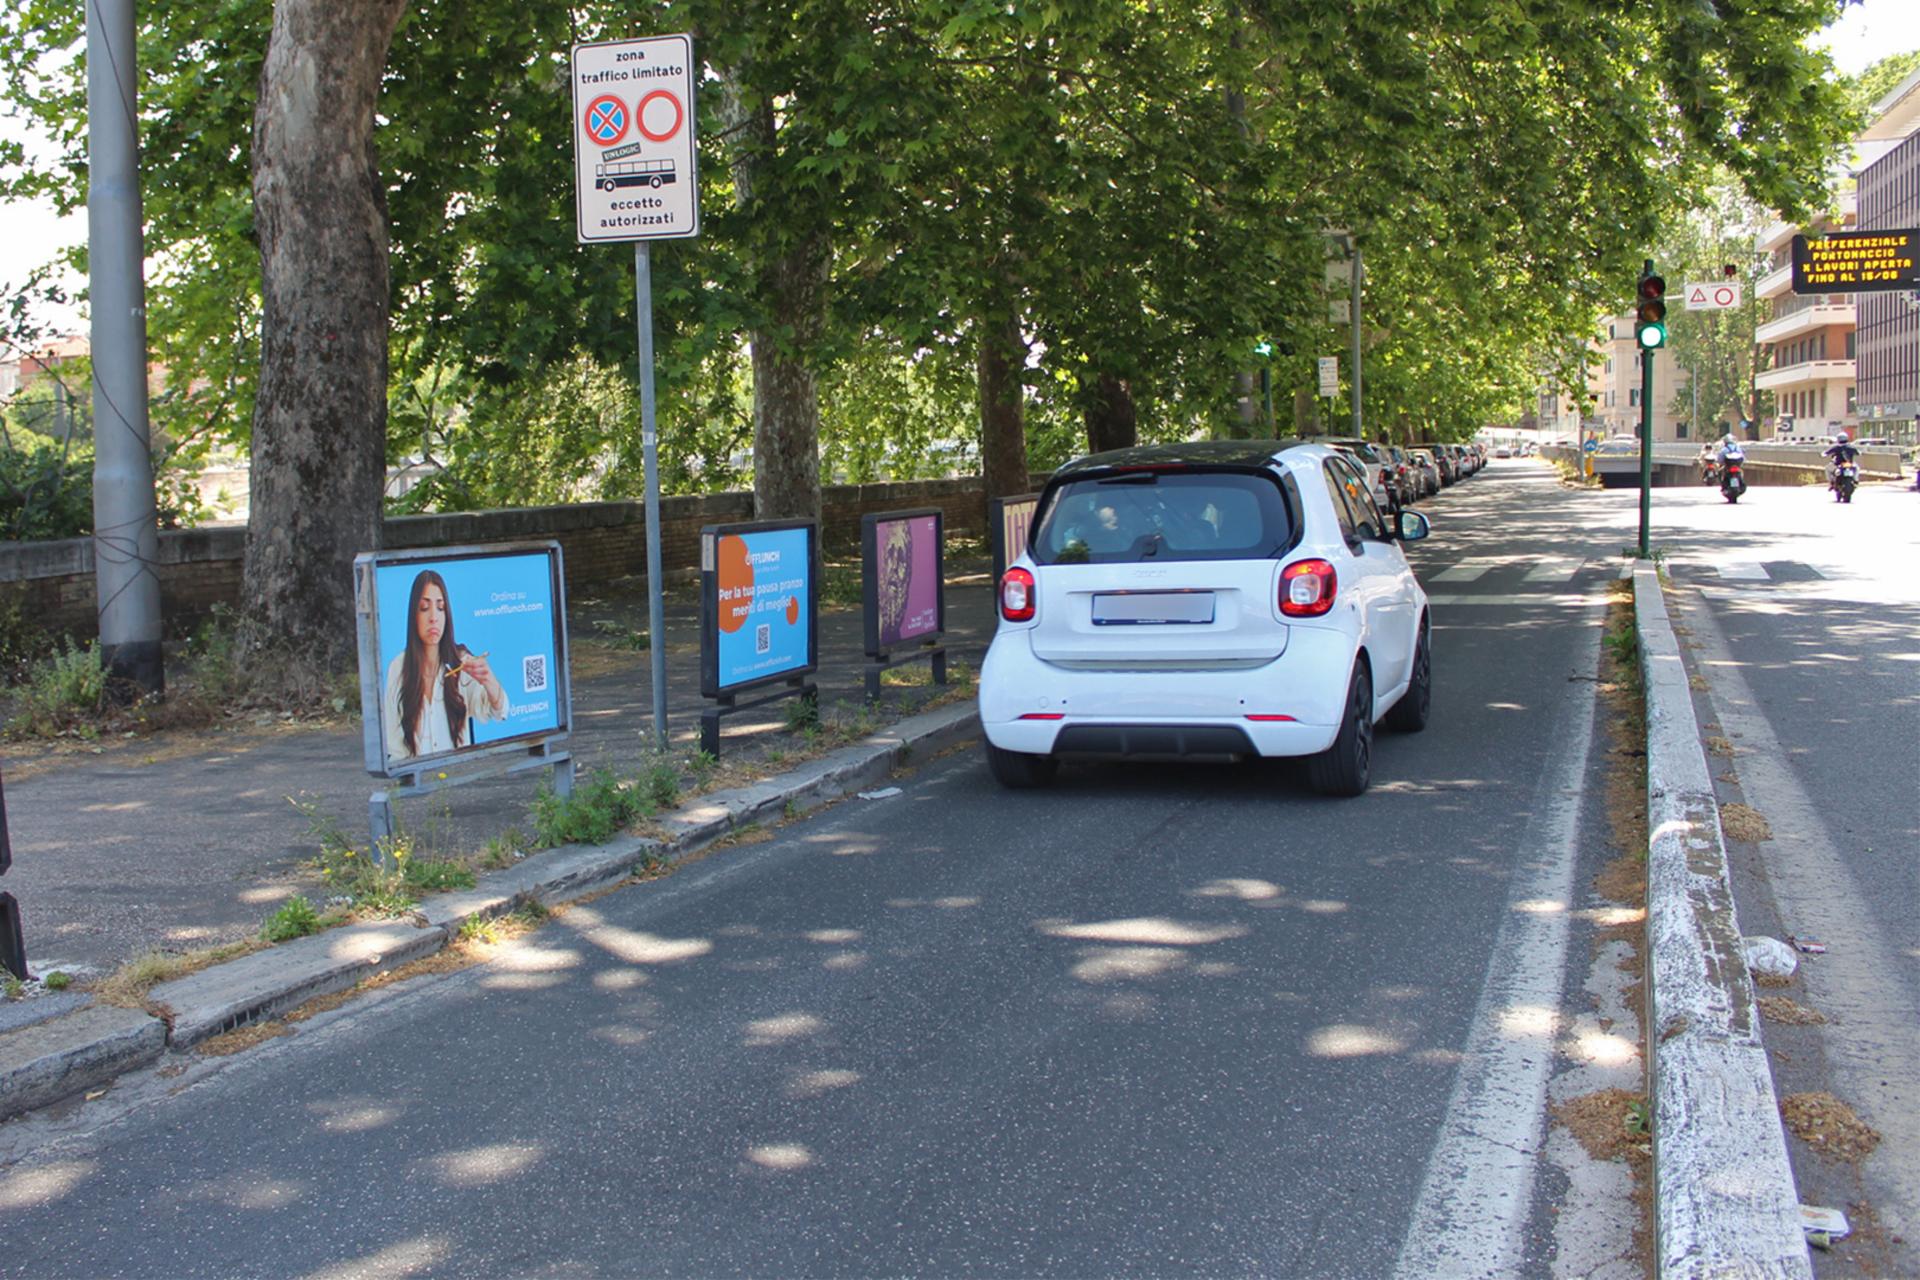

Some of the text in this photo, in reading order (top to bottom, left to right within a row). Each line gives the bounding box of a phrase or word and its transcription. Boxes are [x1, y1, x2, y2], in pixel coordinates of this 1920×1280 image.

[616, 51, 645, 62] zona
[581, 65, 683, 84] traffico limitato
[604, 145, 639, 160] UNLOGIC
[611, 197, 663, 210] eccetto
[600, 213, 674, 227] autorizzati
[1808, 237, 1907, 250] PREFERENZIALE
[1812, 248, 1895, 261] PORTONACCIO
[1802, 258, 1912, 272] X LAVORI APERTA
[1807, 273, 1835, 283] FINO
[1840, 272, 1856, 281] AL
[719, 588, 733, 601] Per
[734, 586, 742, 598] la
[743, 585, 756, 597] tua
[757, 583, 778, 596] pausa
[474, 602, 544, 617] www.offlunch.com
[757, 601, 765, 612] di
